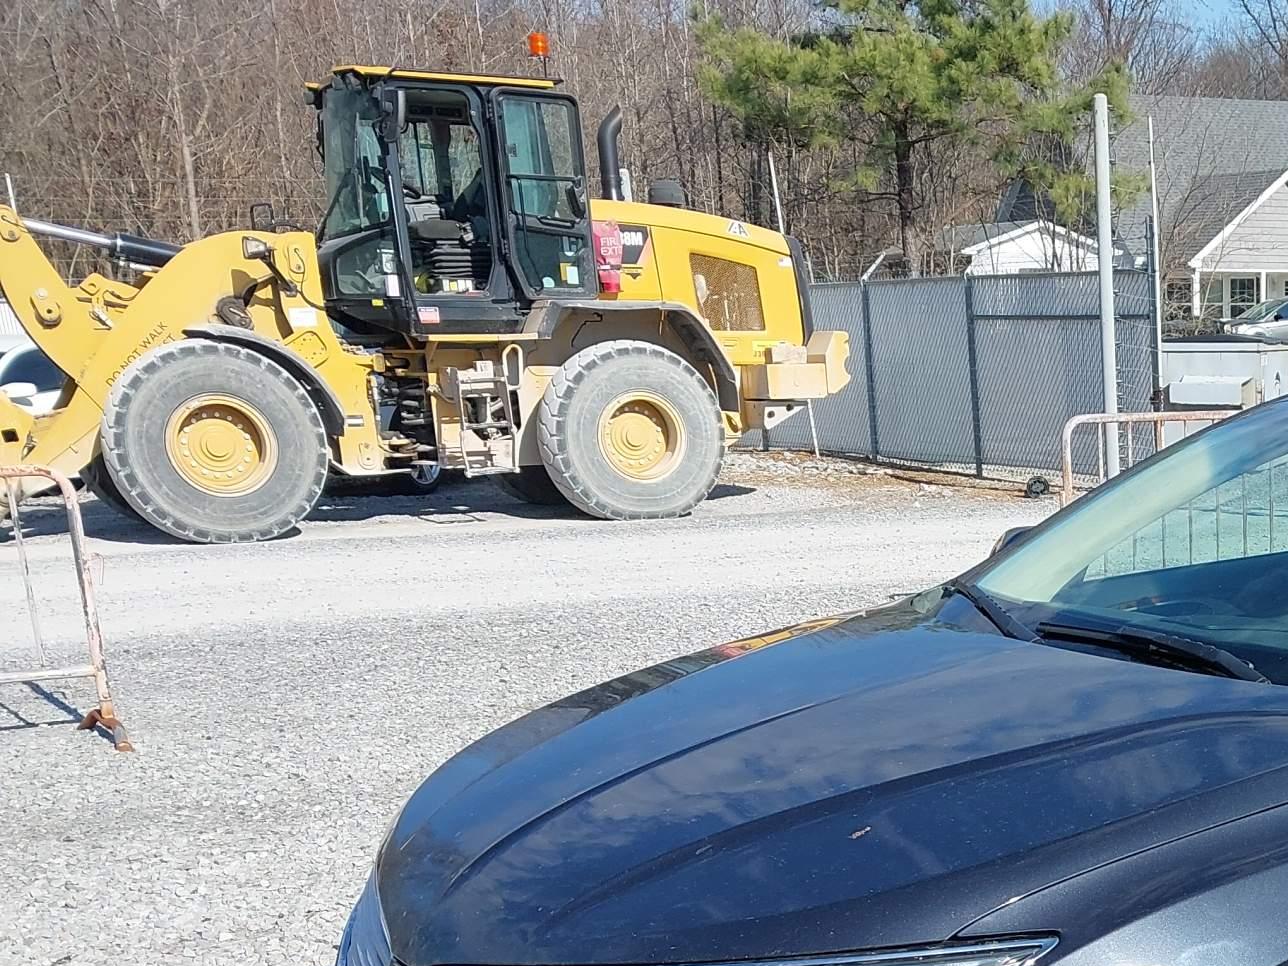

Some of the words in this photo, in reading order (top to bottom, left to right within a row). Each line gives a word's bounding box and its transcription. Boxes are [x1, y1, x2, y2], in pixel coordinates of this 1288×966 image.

[105, 371, 121, 387] DO
[120, 348, 141, 369] NOT
[140, 322, 168, 348] WALK
